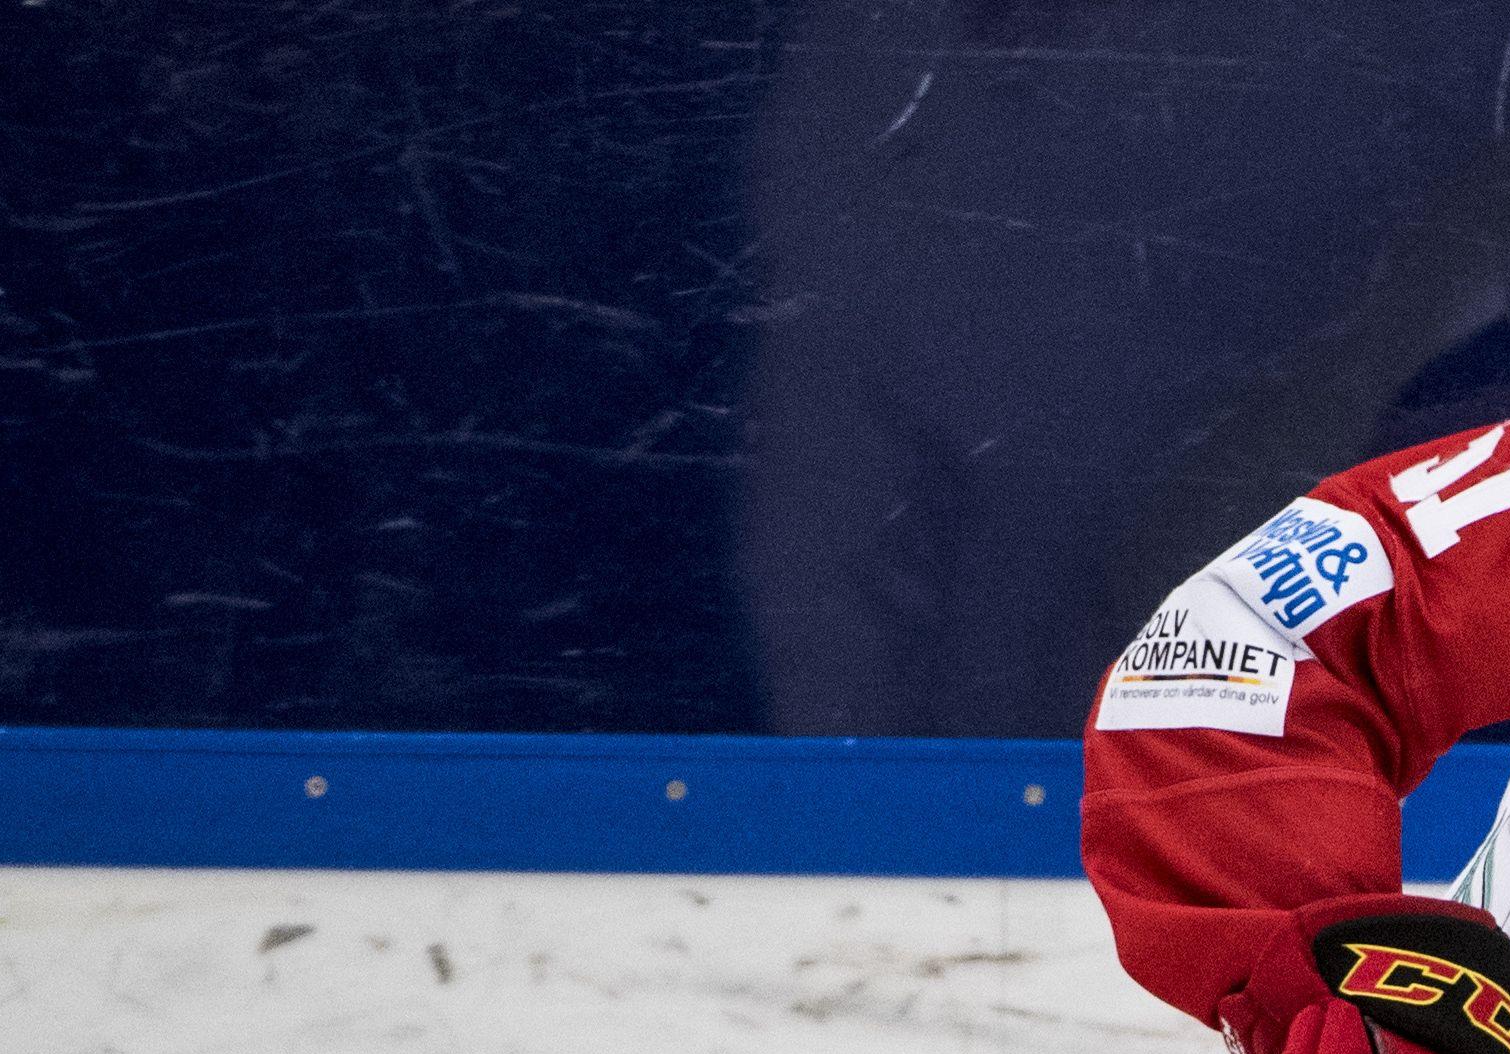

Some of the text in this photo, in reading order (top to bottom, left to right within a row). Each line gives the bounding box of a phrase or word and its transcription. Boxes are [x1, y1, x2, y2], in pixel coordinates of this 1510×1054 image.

[1316, 541, 1369, 597] &
[1117, 638, 1288, 678] KOMPANIET
[1218, 686, 1246, 701] dina
[1249, 690, 1280, 706] golv
